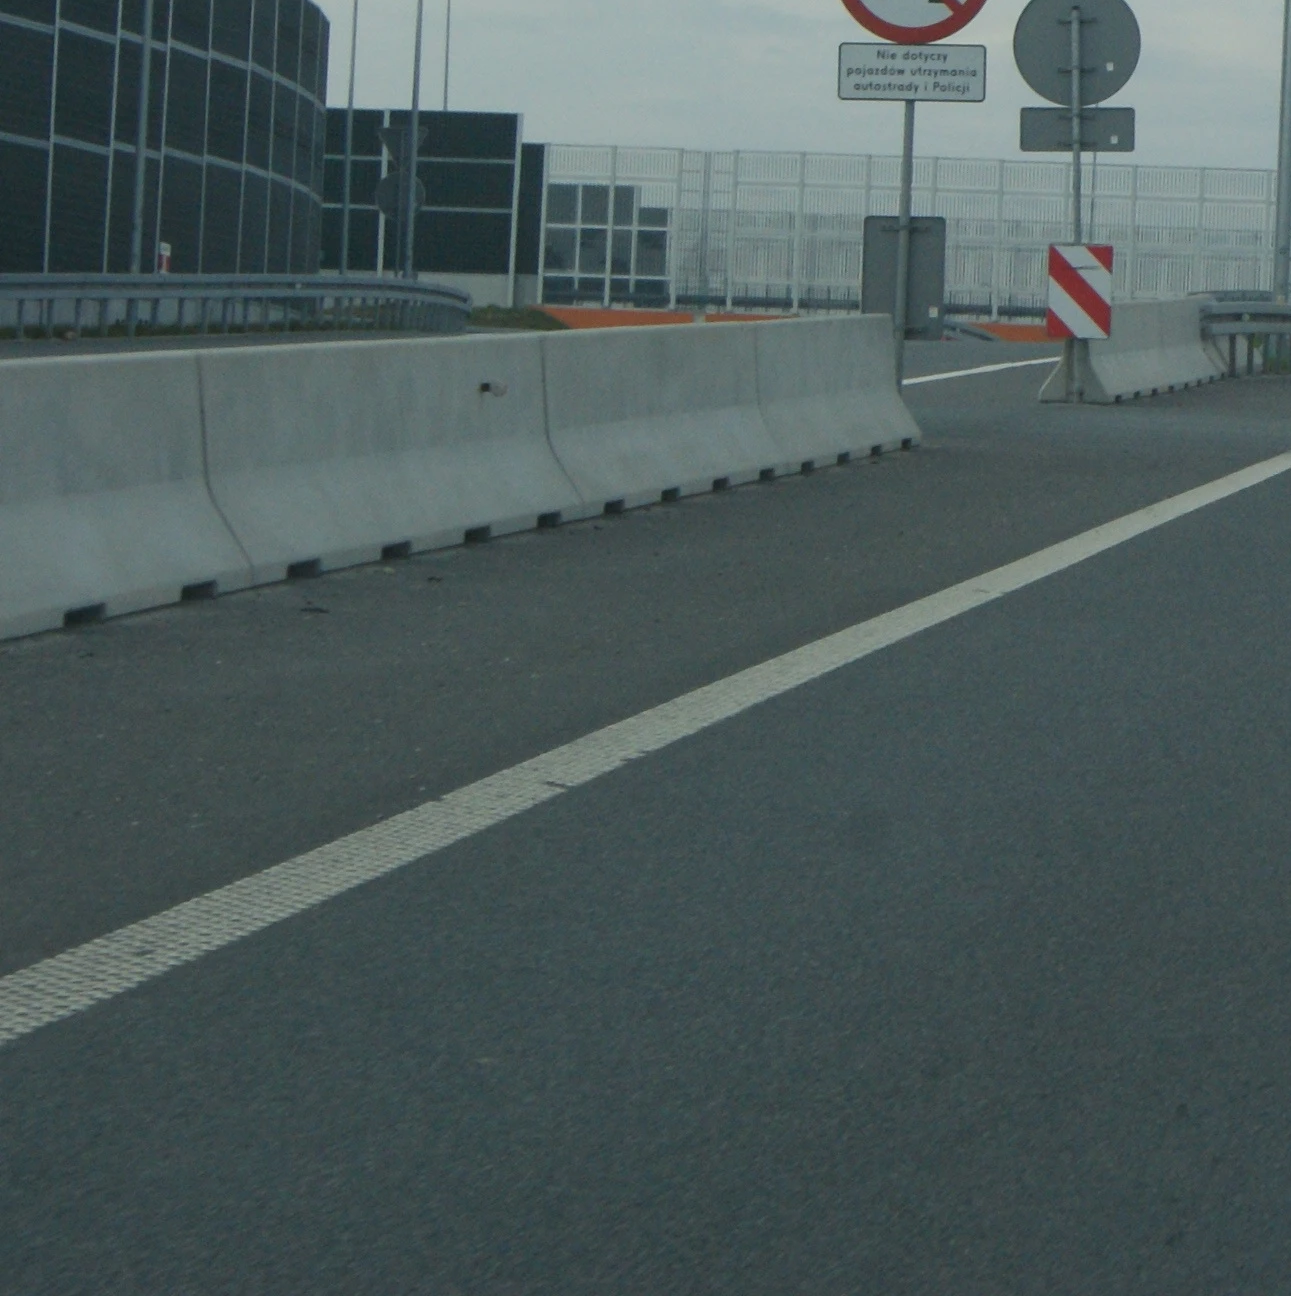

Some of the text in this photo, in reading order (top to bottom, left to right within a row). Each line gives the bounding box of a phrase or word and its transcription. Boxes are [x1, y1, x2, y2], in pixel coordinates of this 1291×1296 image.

[876, 49, 948, 63] Nie dotyczy
[910, 67, 977, 78] utrzymania
[853, 82, 919, 93] autostrady
[932, 81, 970, 95] Policji
